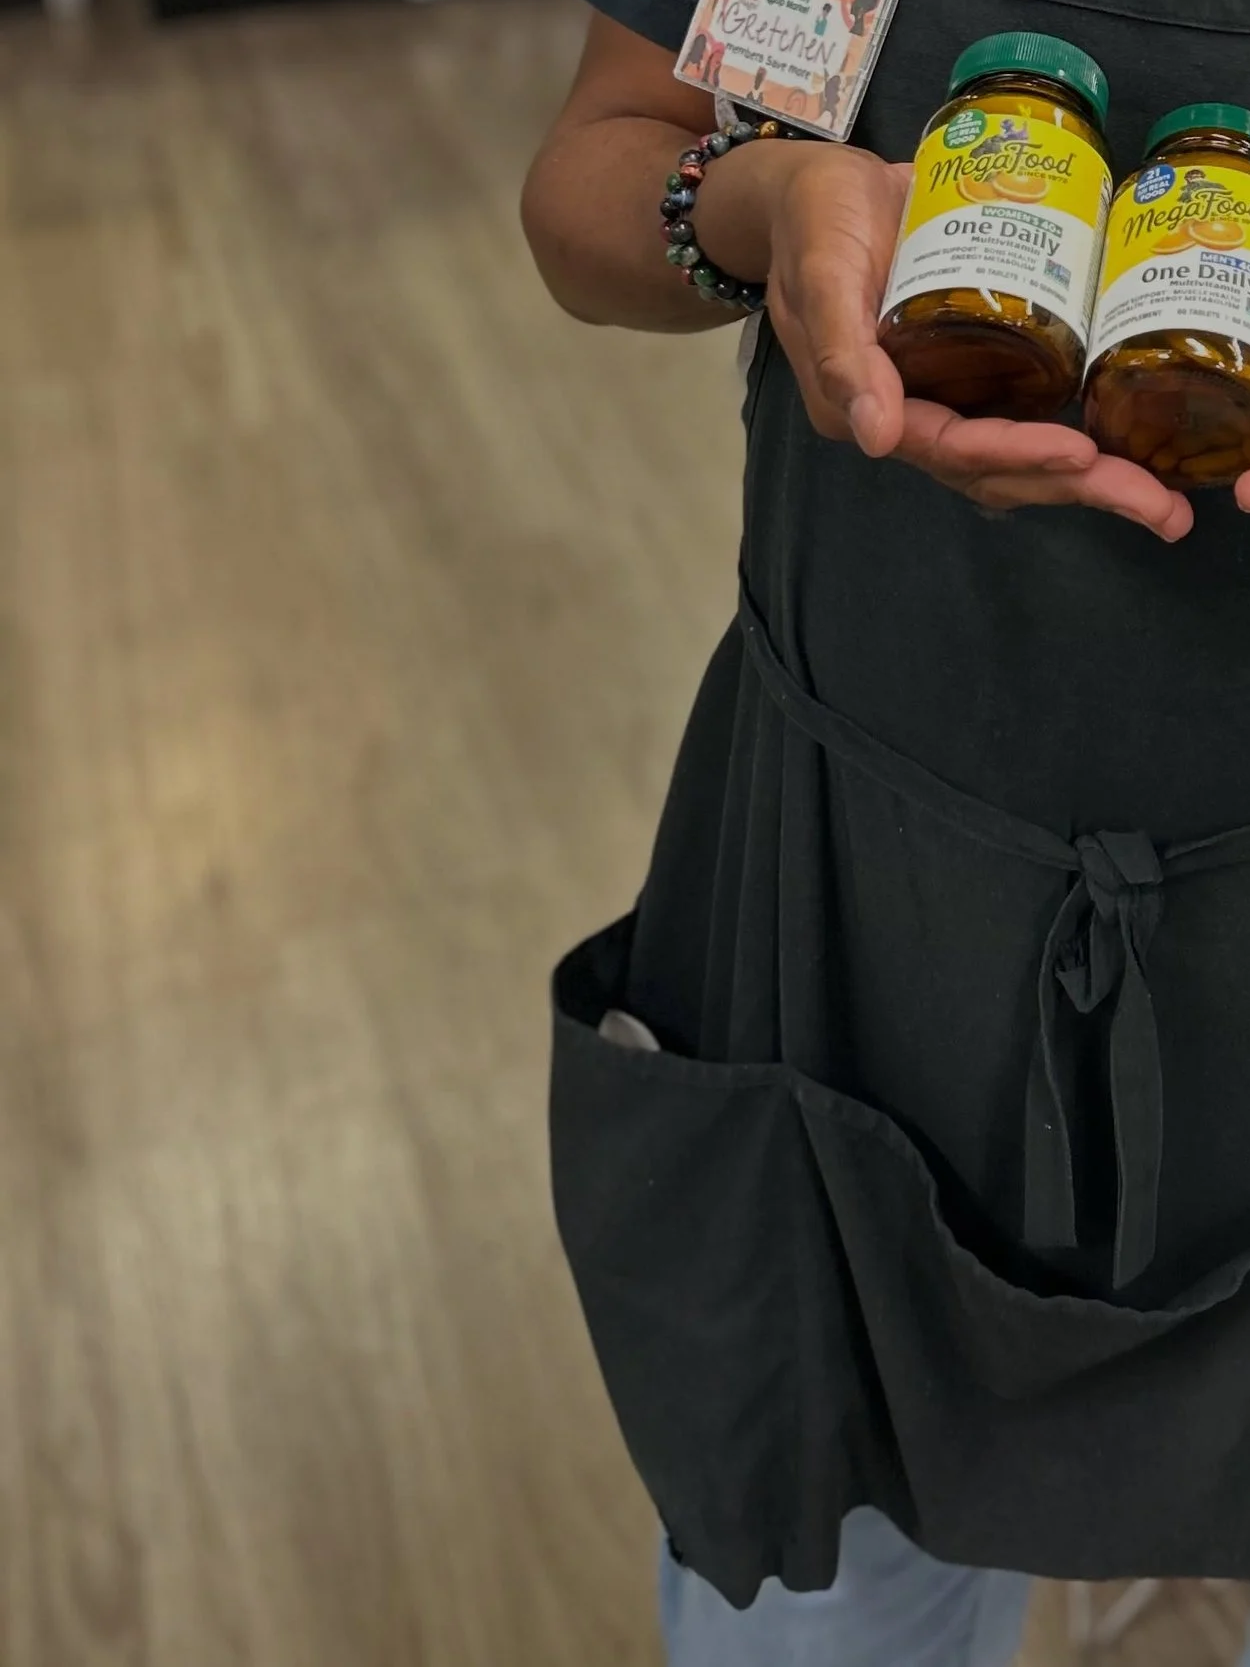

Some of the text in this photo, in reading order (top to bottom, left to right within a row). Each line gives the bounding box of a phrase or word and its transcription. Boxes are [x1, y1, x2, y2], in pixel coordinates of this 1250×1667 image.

[726, 43, 810, 80] members Save more
[957, 113, 973, 122] 22
[929, 141, 1076, 192] MegaFood
[1146, 168, 1160, 179] 21
[983, 206, 1040, 227] WOMEN'S
[944, 220, 1061, 256] One Daily
[971, 236, 1040, 256] Multivitamin
[1202, 252, 1237, 267] MEN'S
[1142, 265, 1190, 283] One
[1169, 280, 1241, 295] Multivitamin
